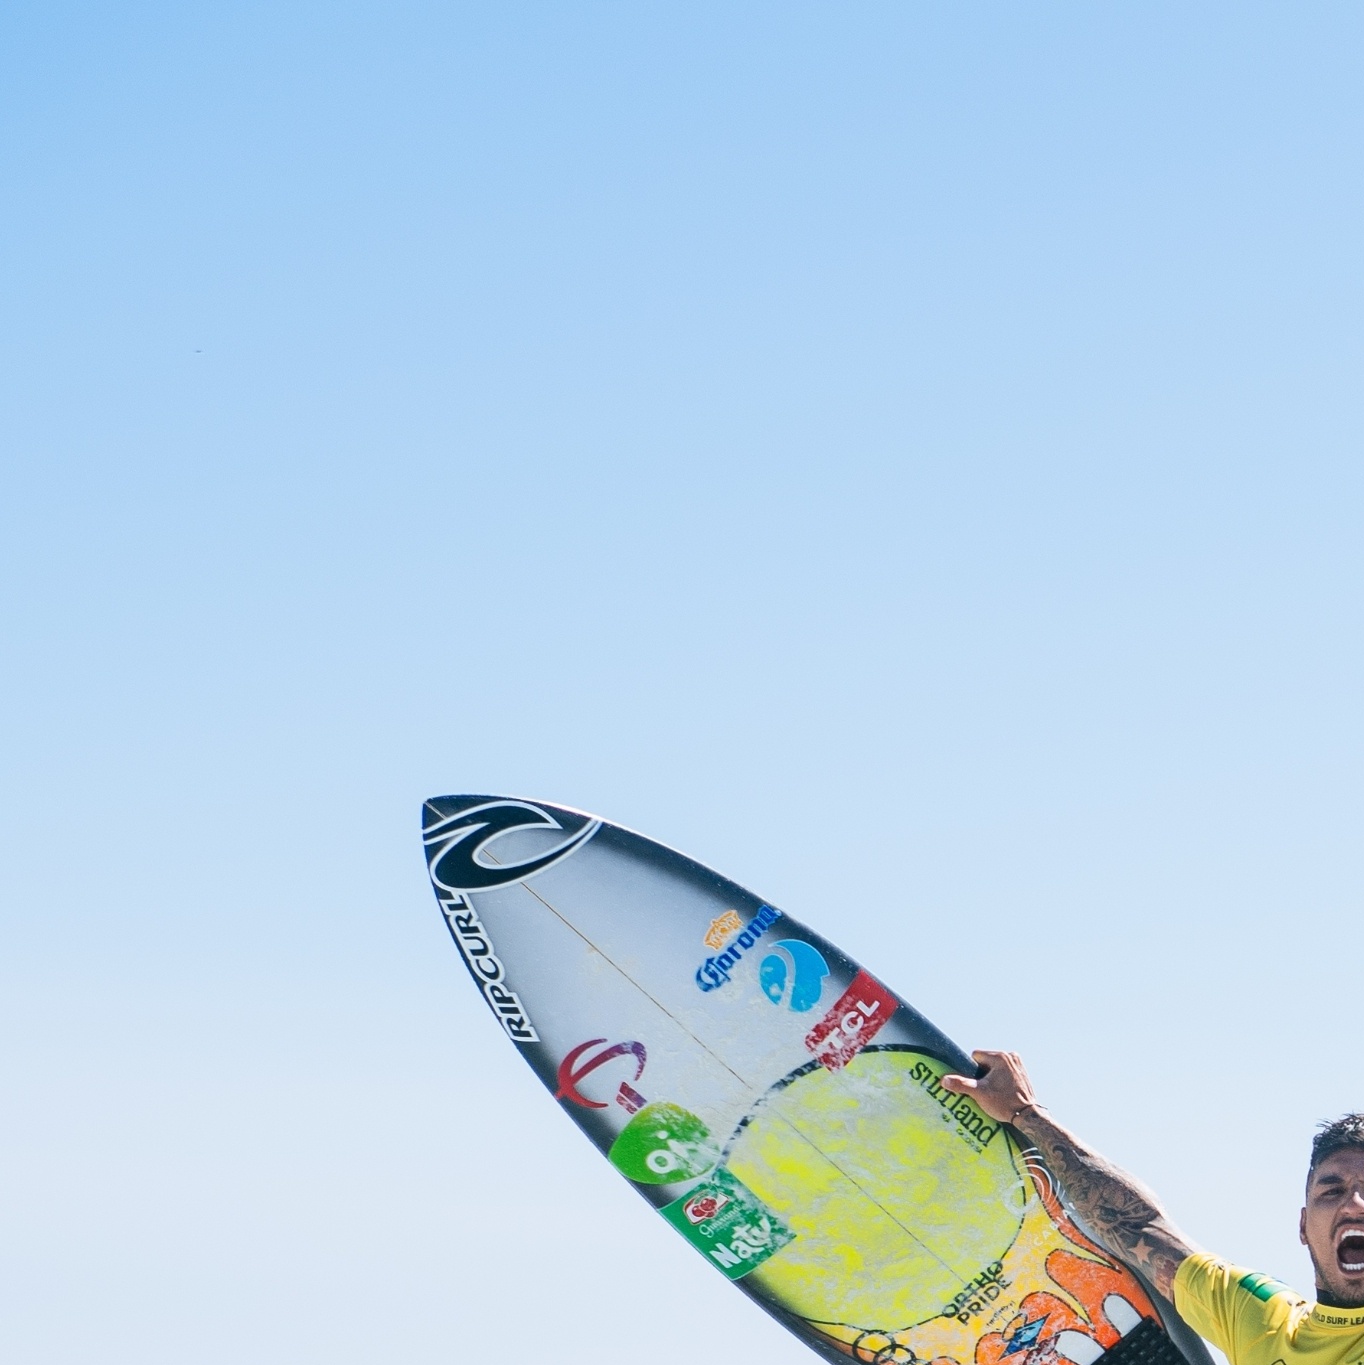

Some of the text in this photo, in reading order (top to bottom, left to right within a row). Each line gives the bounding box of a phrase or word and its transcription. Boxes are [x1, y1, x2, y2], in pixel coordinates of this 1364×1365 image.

[446, 893, 534, 1039] RIP CURL
[695, 904, 776, 993] Corona
[816, 1000, 881, 1050] TCL
[941, 1260, 1004, 1319] ORTHO
[956, 1274, 1013, 1327] PRIDE
[1326, 1315, 1349, 1326] SURF
